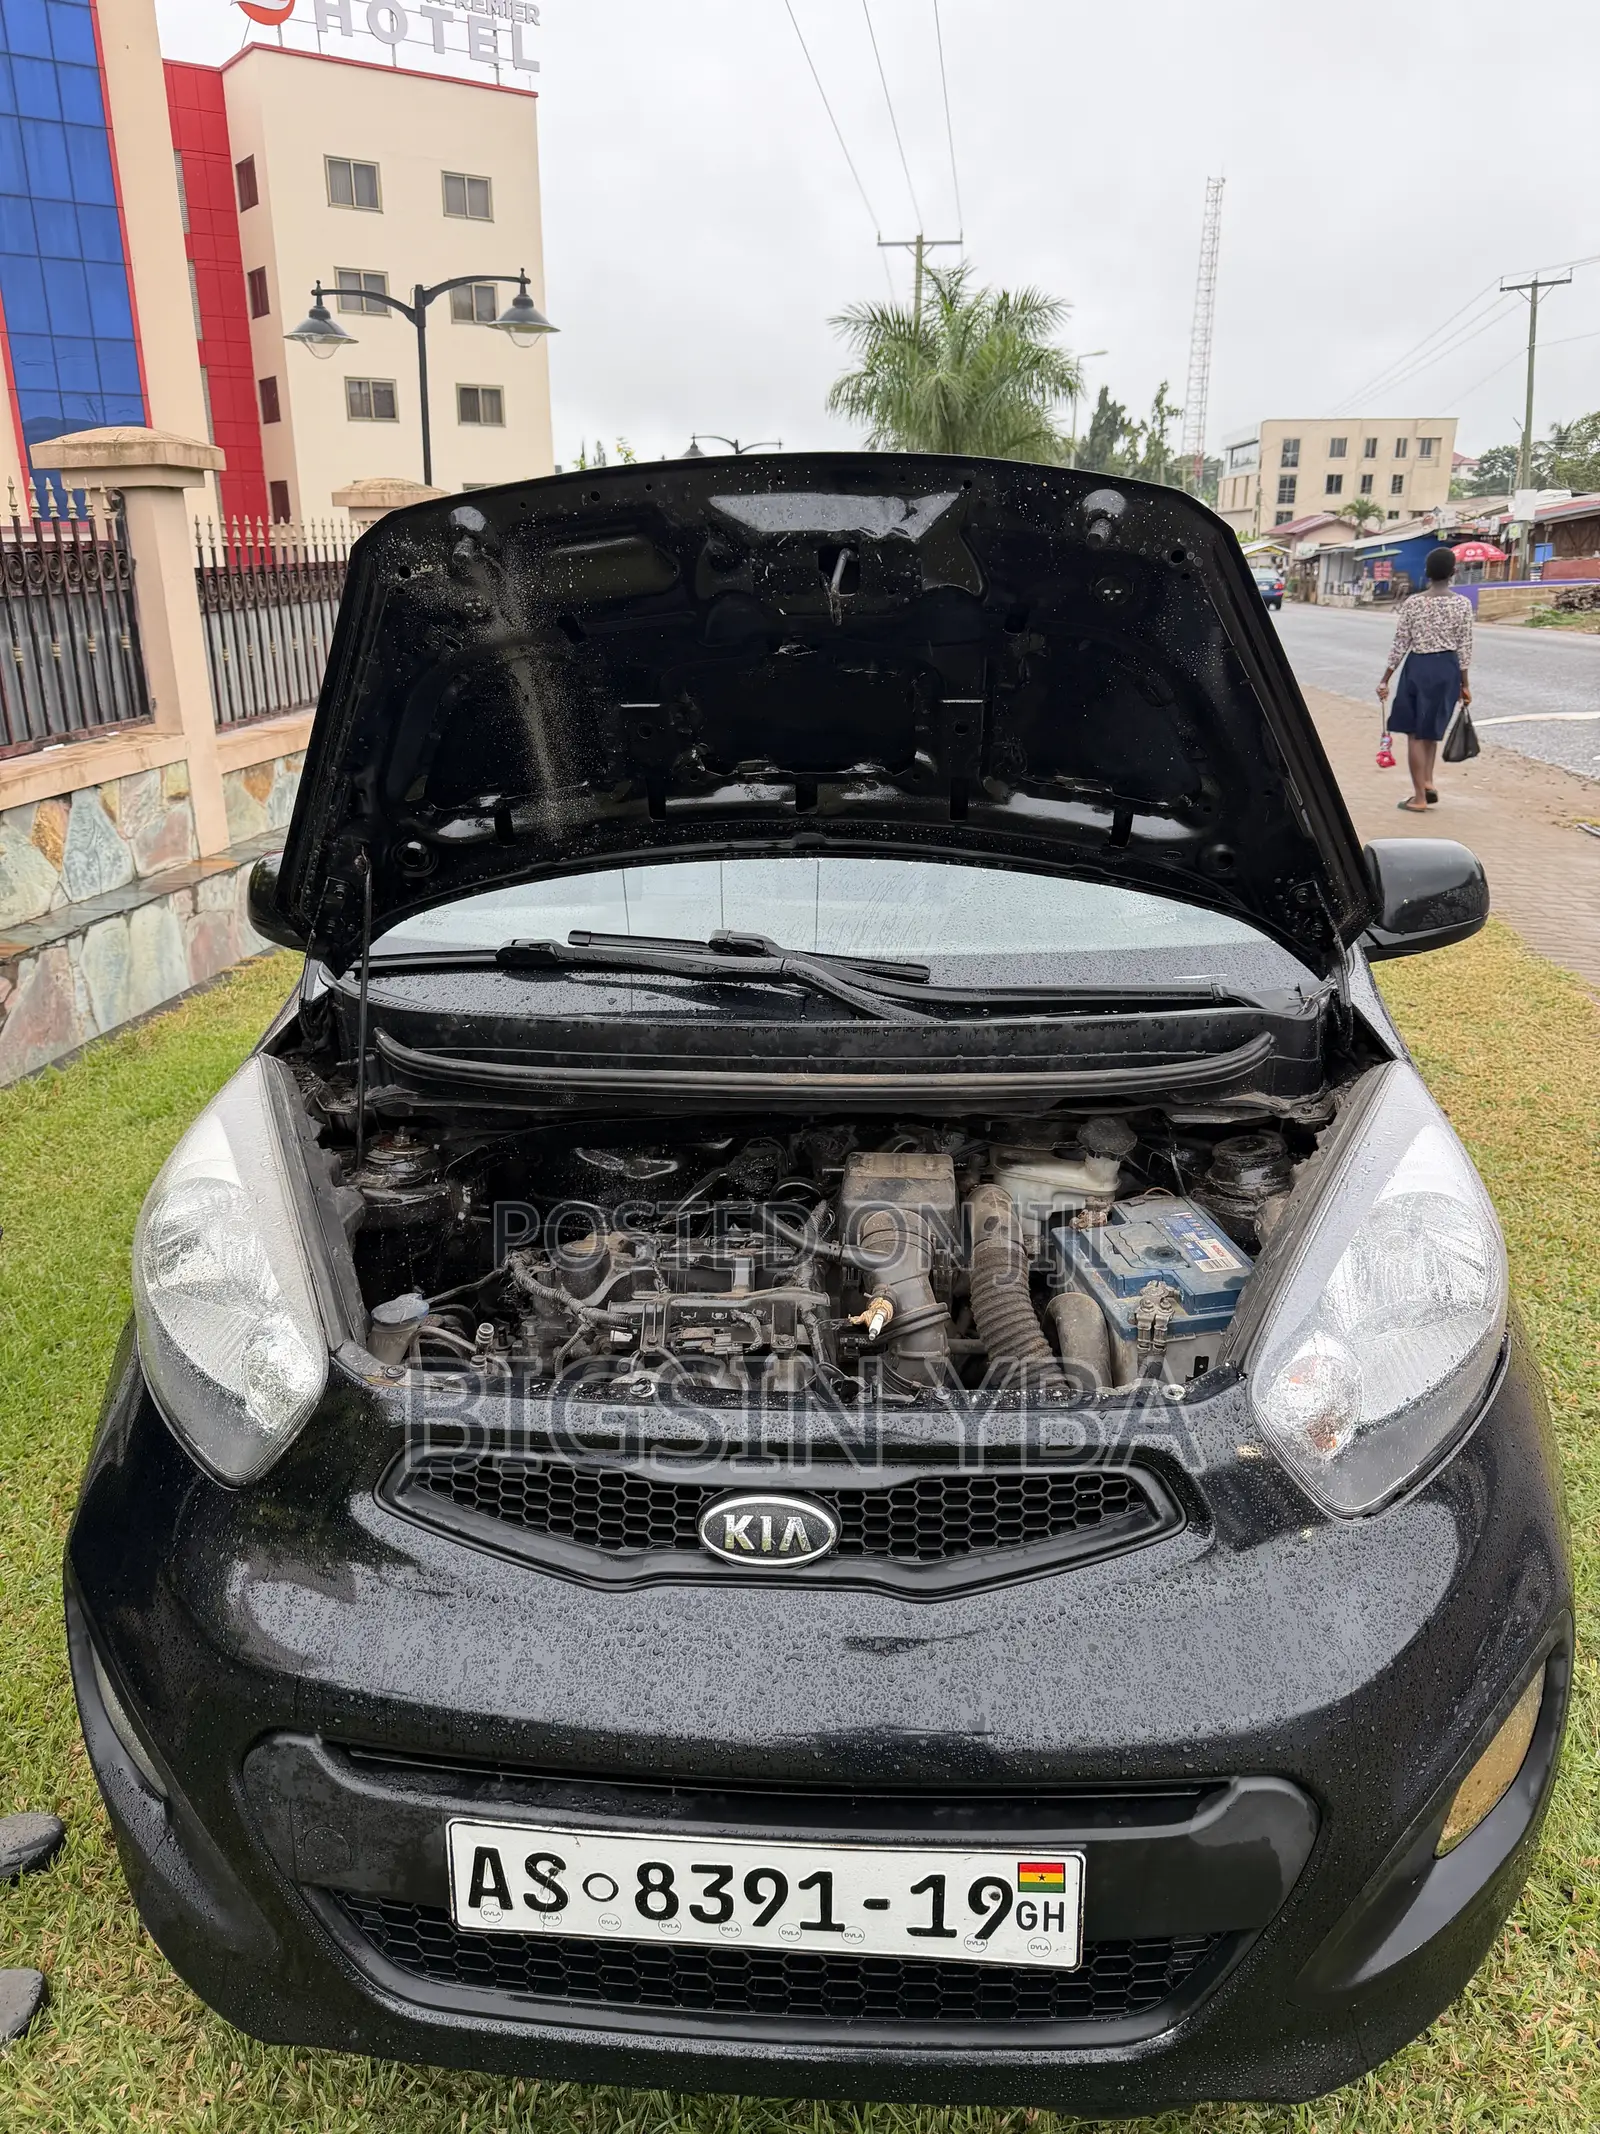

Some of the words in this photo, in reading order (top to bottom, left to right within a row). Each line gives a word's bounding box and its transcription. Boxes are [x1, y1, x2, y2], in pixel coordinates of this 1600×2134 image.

[314, 0, 541, 73] HOTEL
[723, 1513, 812, 1552] KIA
[468, 1845, 569, 1912] AS
[1015, 1900, 1066, 1934] GH
